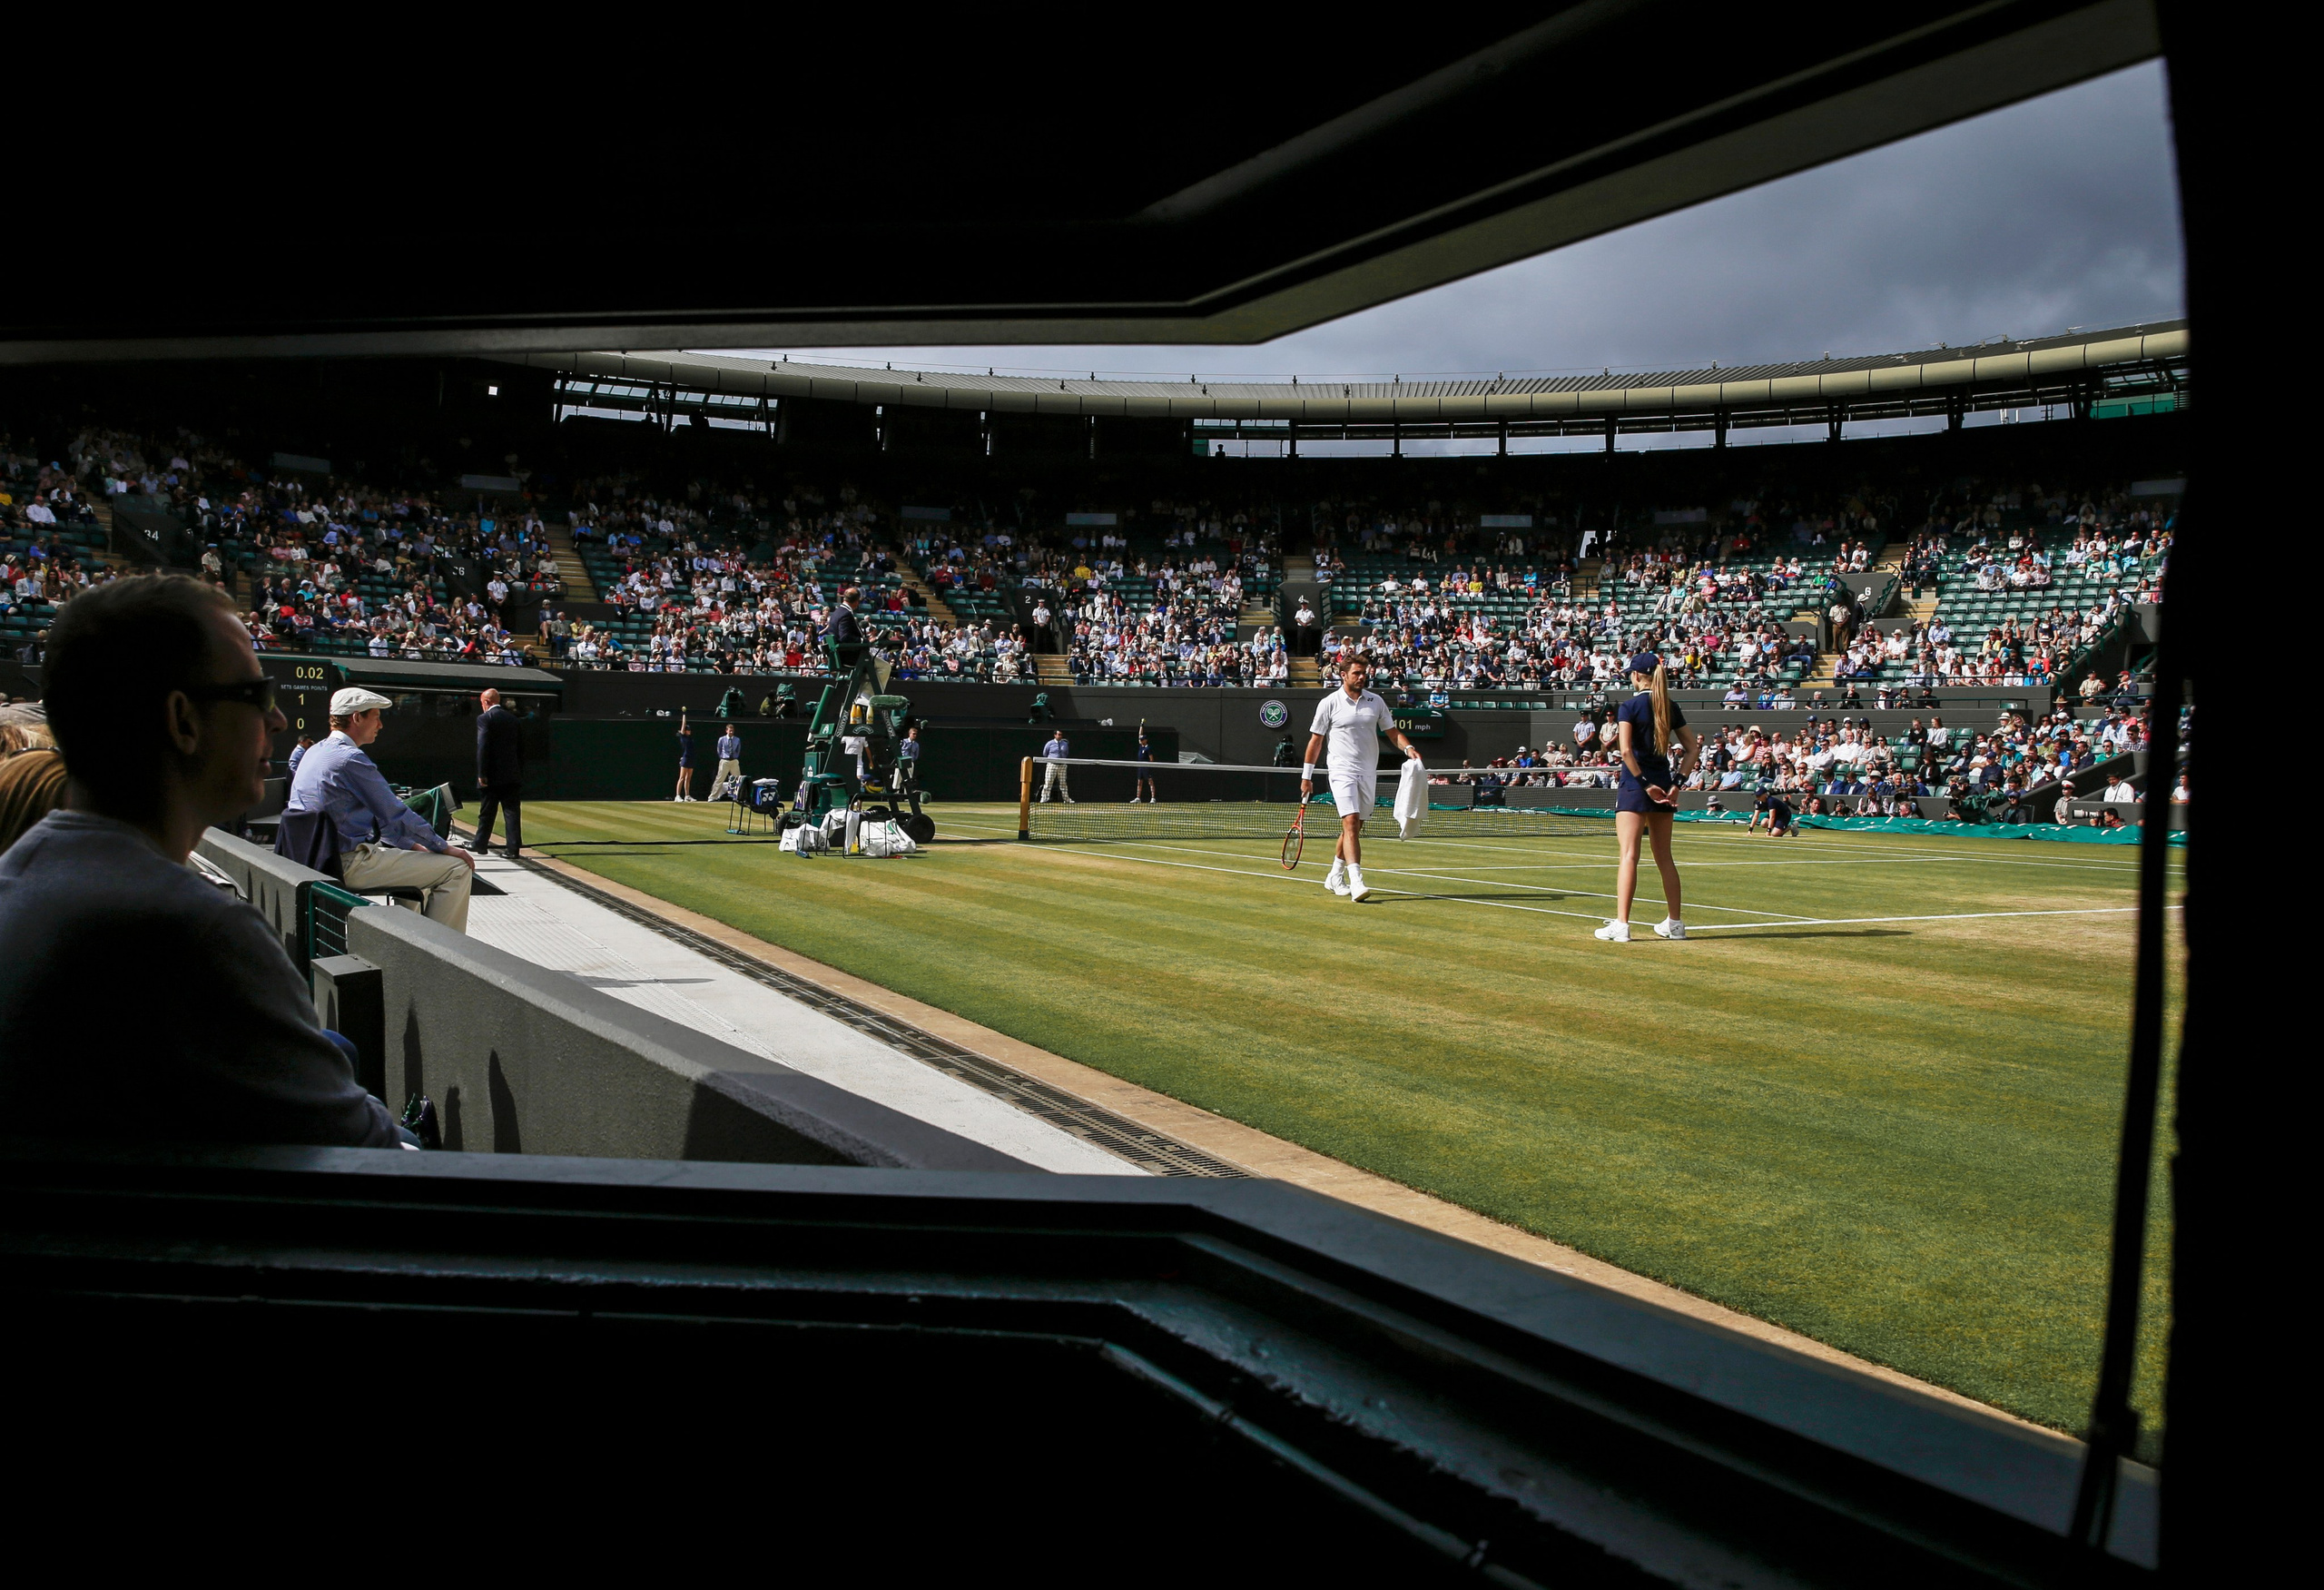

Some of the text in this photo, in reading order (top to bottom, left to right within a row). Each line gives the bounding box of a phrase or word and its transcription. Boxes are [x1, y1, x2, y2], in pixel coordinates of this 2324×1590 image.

[1864, 587, 1872, 597] 6
[1025, 595, 1031, 604] 2
[296, 666, 324, 680] 0.02
[298, 693, 305, 706] 1
[297, 717, 305, 730] 0
[1393, 719, 1413, 730] 101
